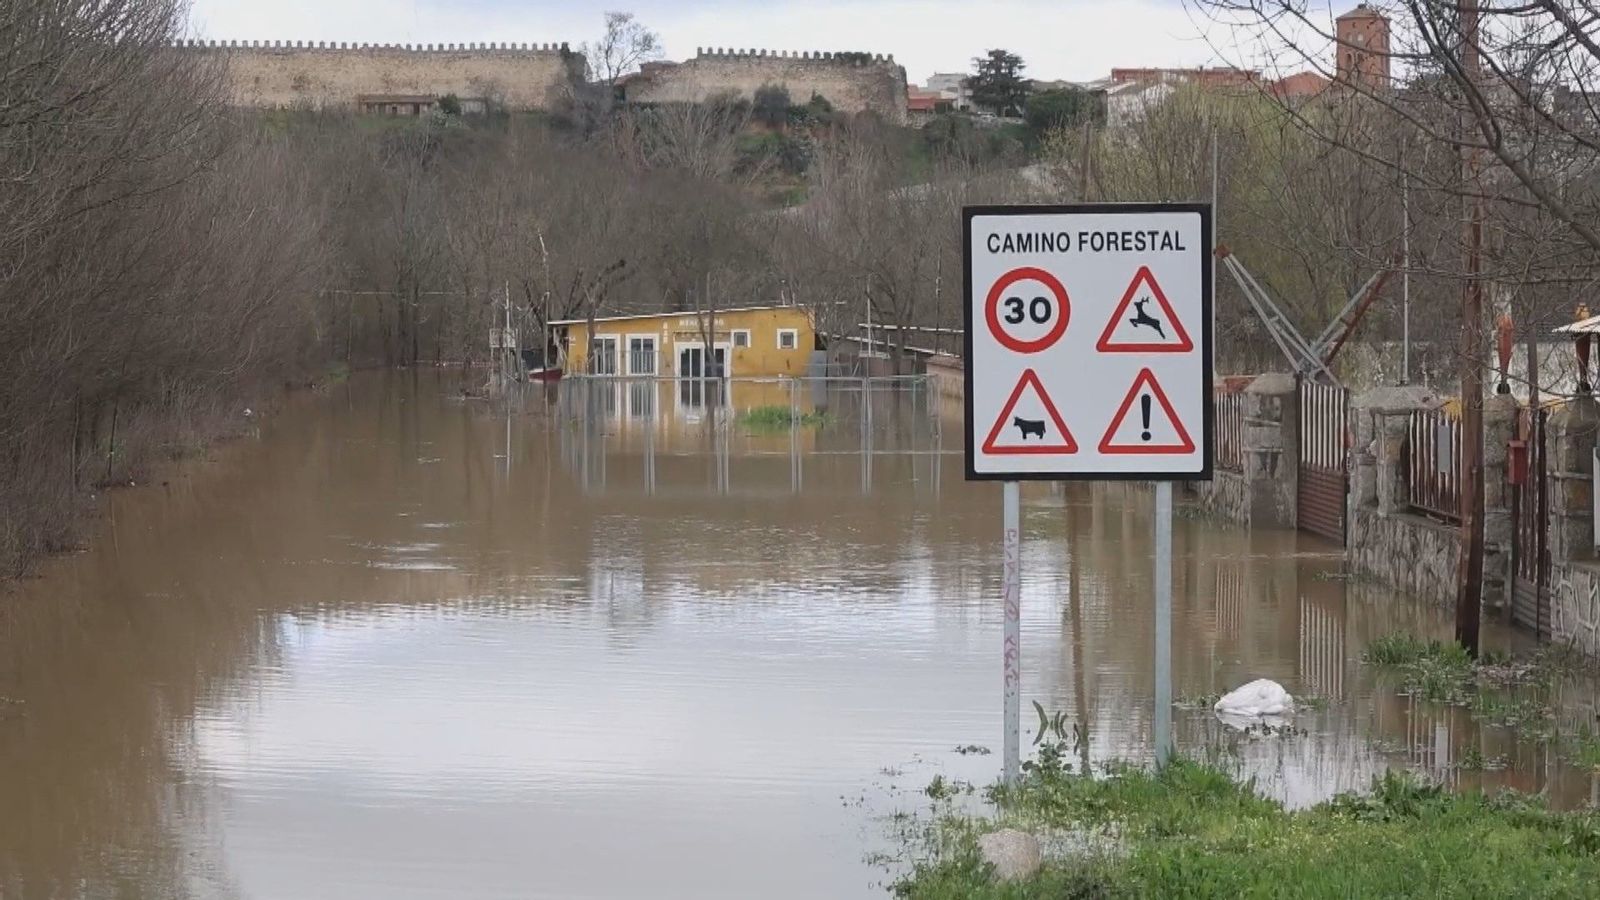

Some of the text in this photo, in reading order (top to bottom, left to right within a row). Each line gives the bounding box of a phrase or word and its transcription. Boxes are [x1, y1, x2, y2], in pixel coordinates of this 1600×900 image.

[987, 230, 1186, 253] CAMINO FORESTAL
[1004, 297, 1052, 325] 30
